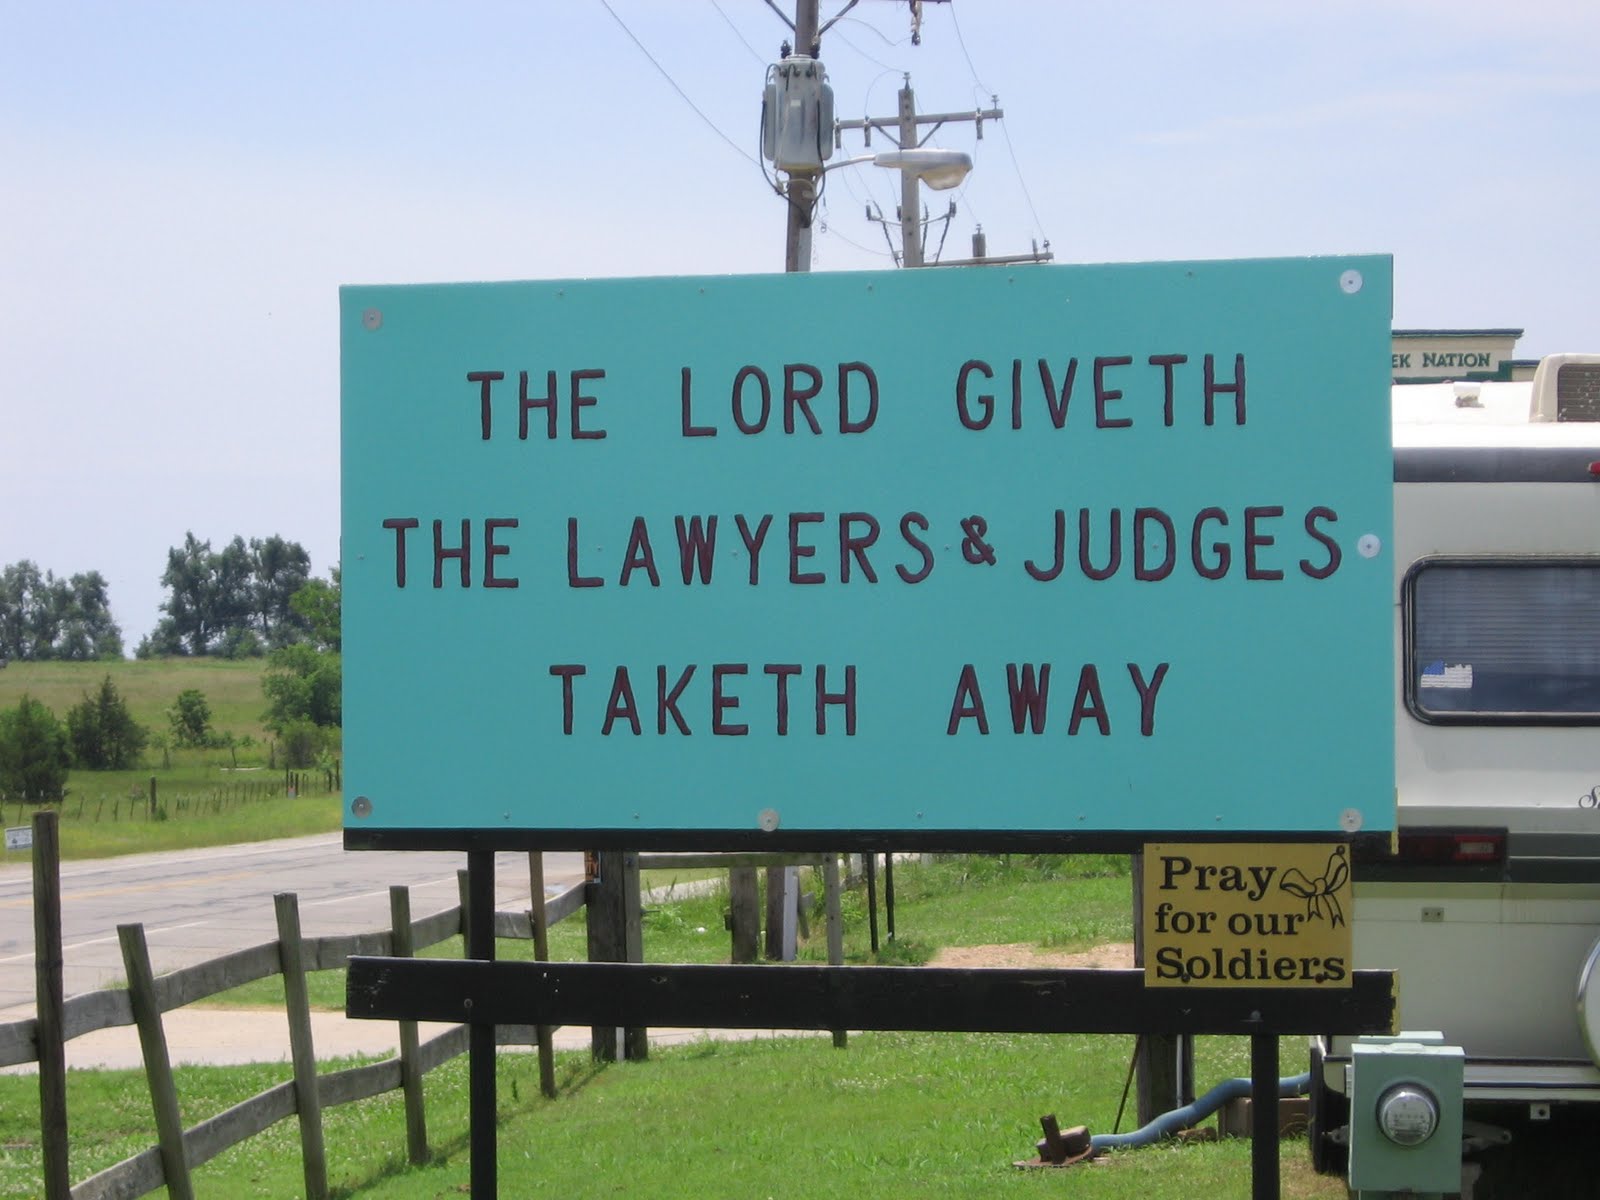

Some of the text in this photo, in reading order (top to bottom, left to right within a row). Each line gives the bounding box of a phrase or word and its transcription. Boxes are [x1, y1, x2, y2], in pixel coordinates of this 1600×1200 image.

[1422, 352, 1491, 368] NATION
[468, 354, 1246, 440] THE LORD GIVETH
[384, 506, 1341, 588] THE LAWYERS & JUDGES
[550, 663, 1168, 737] TAKETH AWAY
[1159, 856, 1277, 901] Pray
[1155, 902, 1305, 935] for our
[1156, 946, 1346, 981] Soldiers
